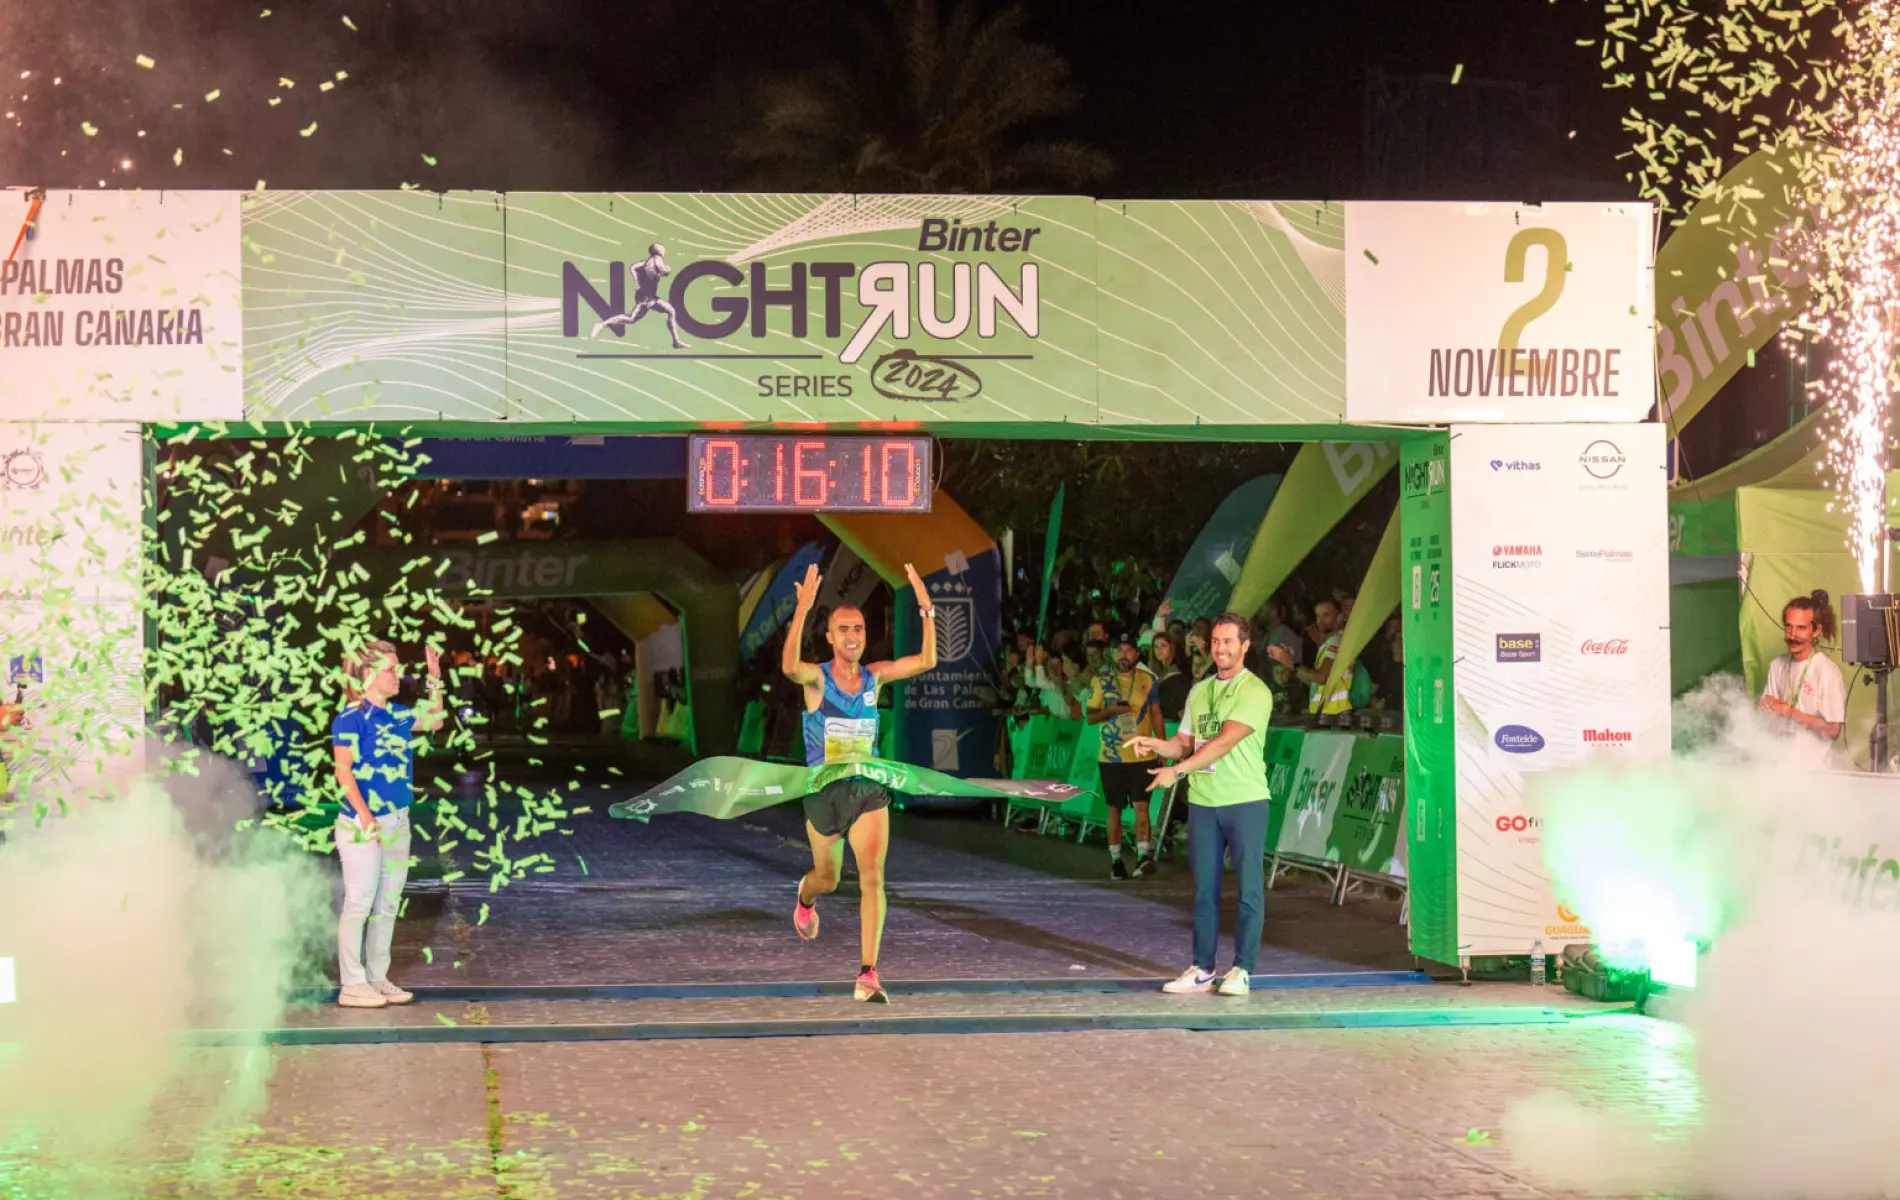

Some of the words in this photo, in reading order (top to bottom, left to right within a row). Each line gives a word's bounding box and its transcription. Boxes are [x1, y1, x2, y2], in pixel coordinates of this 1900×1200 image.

[919, 218, 1041, 252] Binter
[0, 257, 124, 296] PALMAS
[1497, 227, 1568, 378] 2
[0, 310, 64, 348] RAN
[75, 308, 204, 346] CANARIA
[757, 374, 853, 398] SERIES
[882, 356, 960, 398] 2024
[1428, 348, 1621, 398] NOVIEMBRE
[706, 440, 915, 507] 0:16:10
[1506, 460, 1542, 471] vithas
[1579, 455, 1627, 464] NISSAN
[1503, 545, 1543, 557] YAMAHA
[440, 551, 589, 589] Binter
[919, 698, 949, 710] Gran
[924, 684, 945, 695] Las
[1582, 729, 1633, 742] Mahou
